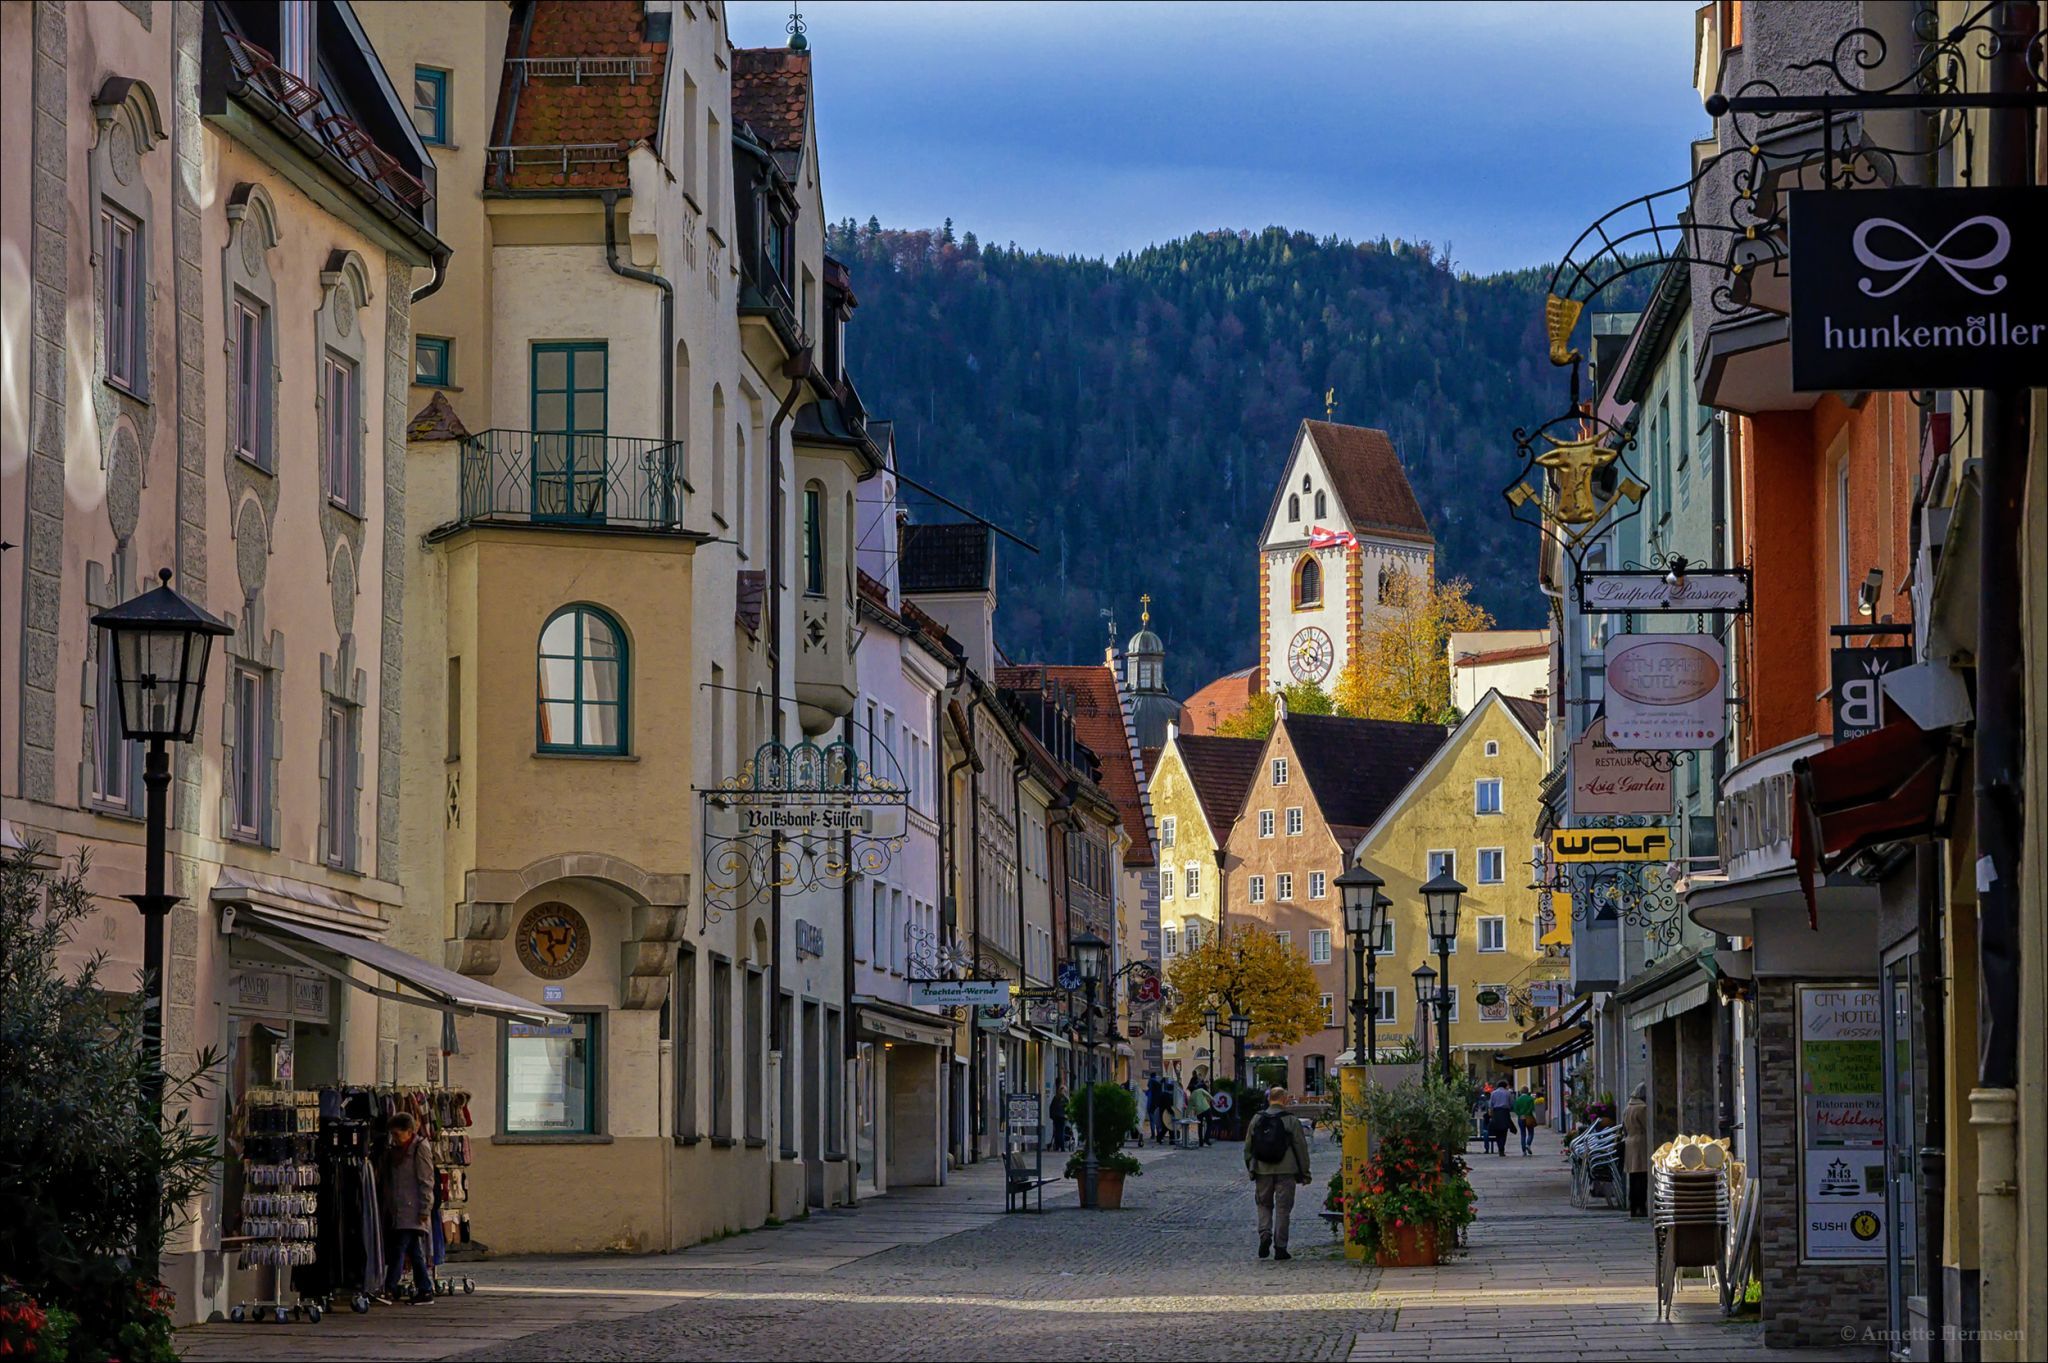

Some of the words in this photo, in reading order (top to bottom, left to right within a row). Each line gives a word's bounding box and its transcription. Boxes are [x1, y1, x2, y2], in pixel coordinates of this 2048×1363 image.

[1824, 312, 2047, 349] hunkemöller
[1597, 580, 1670, 605] Luitpold
[1669, 582, 1738, 606] Passage
[1578, 776, 1618, 796] Asia
[1556, 835, 1666, 855] WOLF
[1814, 993, 1846, 1007] CITY
[1854, 993, 1882, 1006] APA
[1833, 1010, 1881, 1024] HOTEL
[1816, 1100, 1862, 1109] Ristorante
[1866, 1100, 1883, 1109] Piz
[1816, 1110, 1884, 1131] Michelang
[1811, 1222, 1848, 1231] SUSHI
